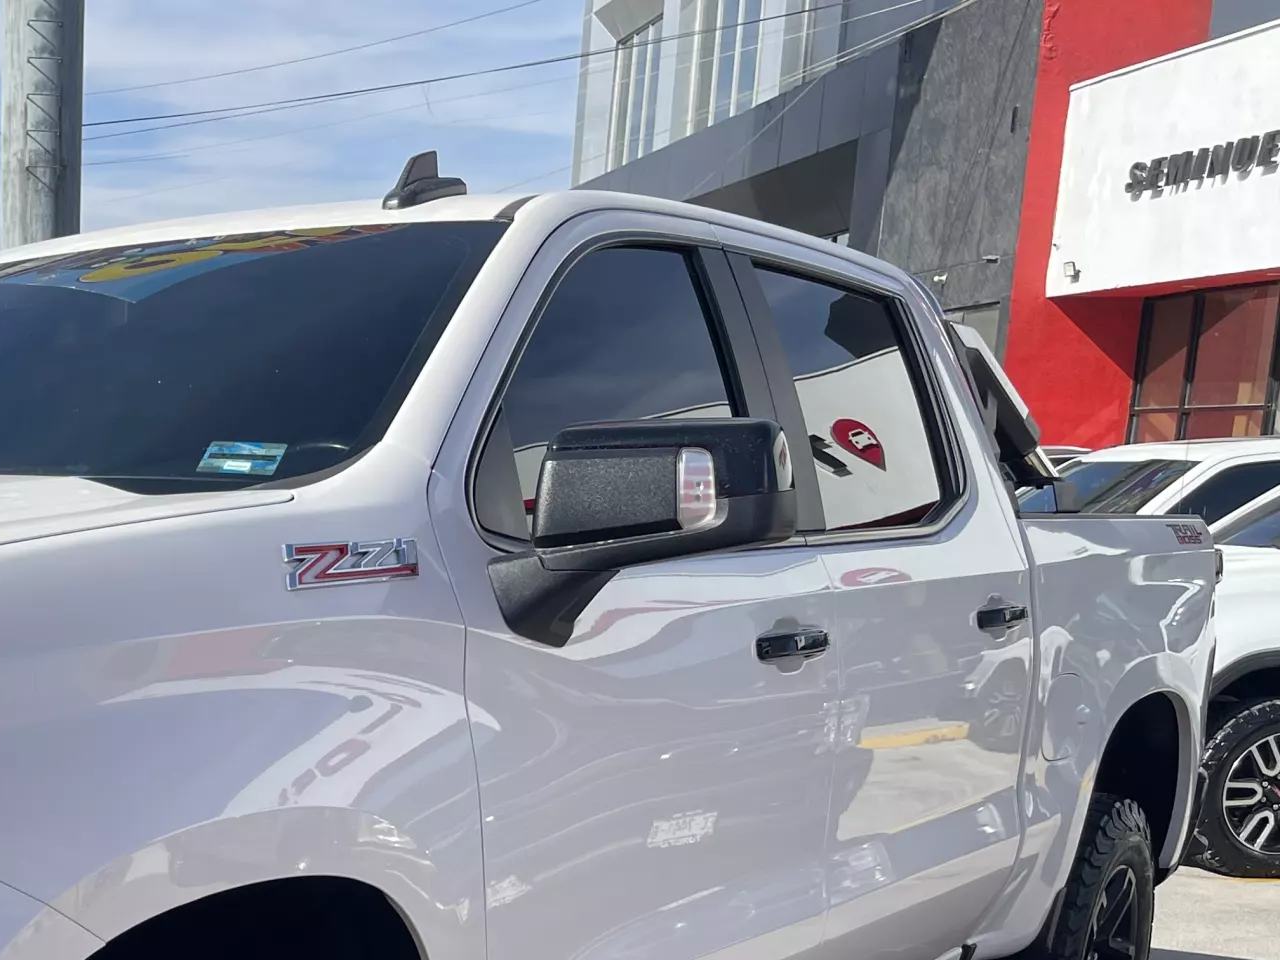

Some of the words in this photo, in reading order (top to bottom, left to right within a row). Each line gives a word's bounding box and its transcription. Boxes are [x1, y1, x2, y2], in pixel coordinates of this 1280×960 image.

[1165, 523, 1202, 535] TRAIL
[1176, 535, 1202, 545] BOSS
[281, 537, 420, 591] Z71
